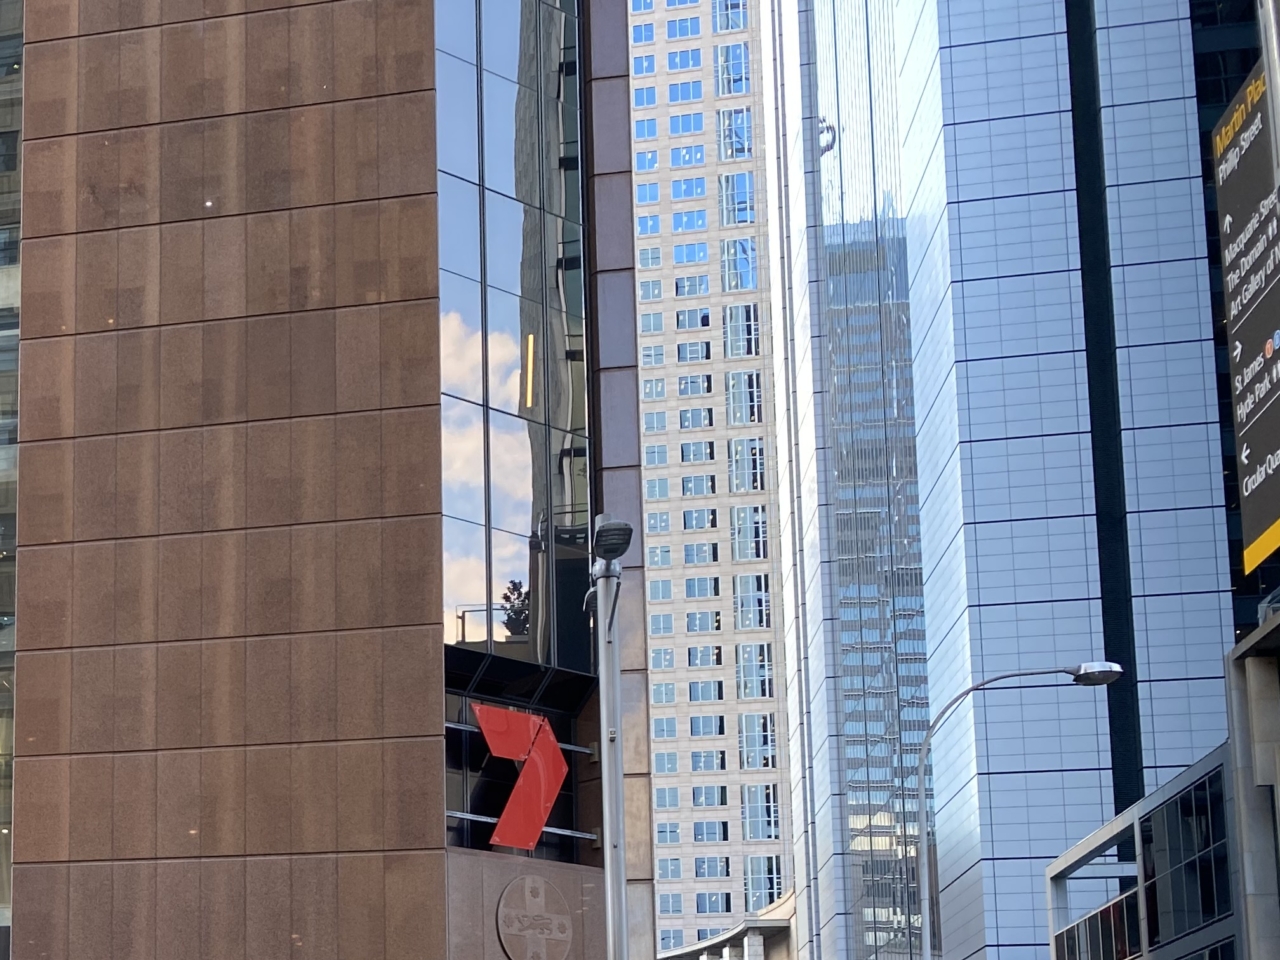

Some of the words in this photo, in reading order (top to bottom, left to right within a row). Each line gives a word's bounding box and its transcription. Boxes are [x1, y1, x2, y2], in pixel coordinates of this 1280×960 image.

[1215, 103, 1247, 158] Martin
[1218, 144, 1241, 186] Phillip
[1240, 112, 1263, 155] Street
[1225, 212, 1260, 267] Macquarie
[1226, 266, 1241, 293] The
[1240, 233, 1268, 273] Domain
[1230, 294, 1242, 321] Art
[1241, 266, 1267, 304] Gallery
[1266, 249, 1275, 274] of
[1235, 371, 1244, 395] St
[1243, 351, 1265, 386] James
[1236, 392, 1255, 422] Hyde
[1254, 373, 1271, 403] Park
[1243, 462, 1267, 497] Circular
